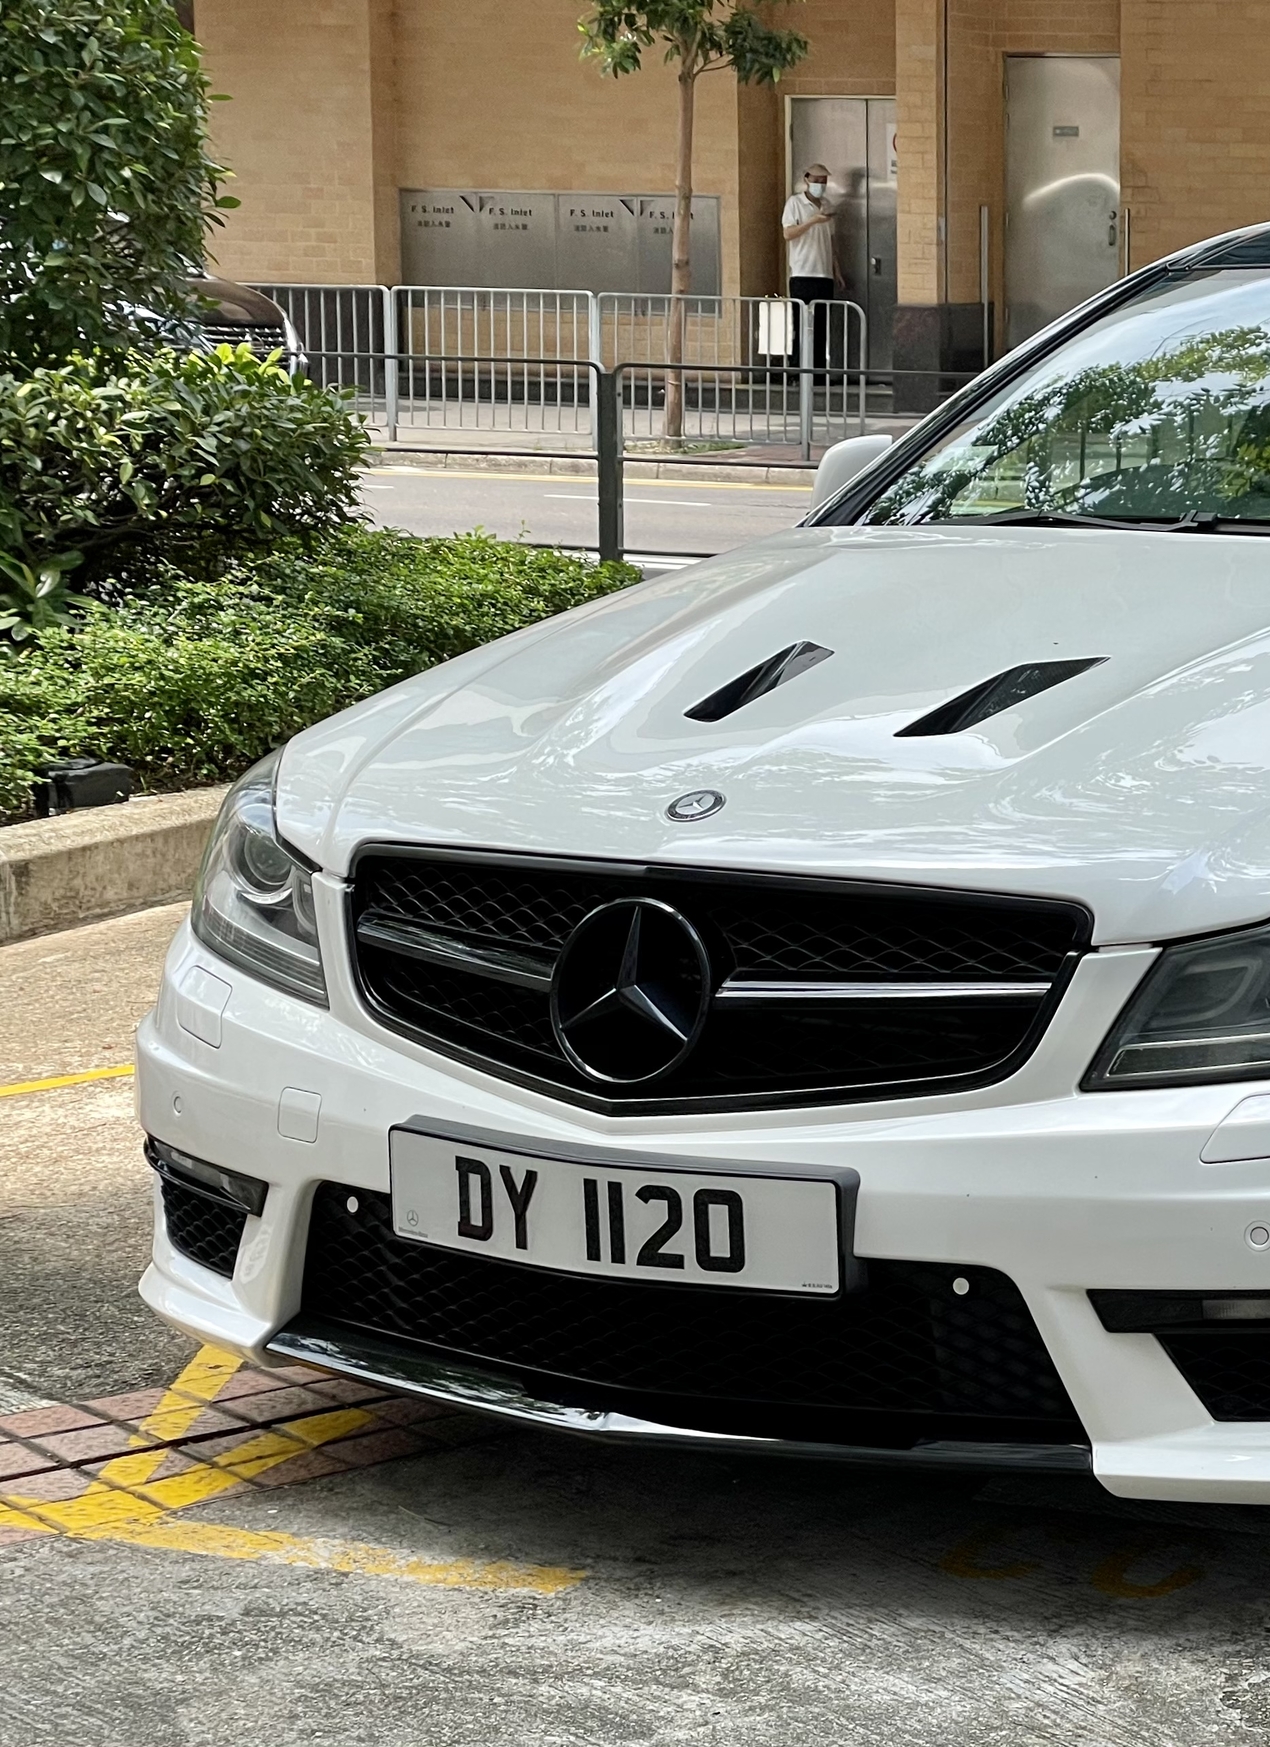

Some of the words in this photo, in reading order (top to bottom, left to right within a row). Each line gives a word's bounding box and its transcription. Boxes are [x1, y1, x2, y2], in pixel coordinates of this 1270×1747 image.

[511, 208, 533, 217] Inlet
[592, 209, 614, 218] Inlet
[455, 1155, 538, 1250] DY
[583, 1177, 745, 1273] 1120
